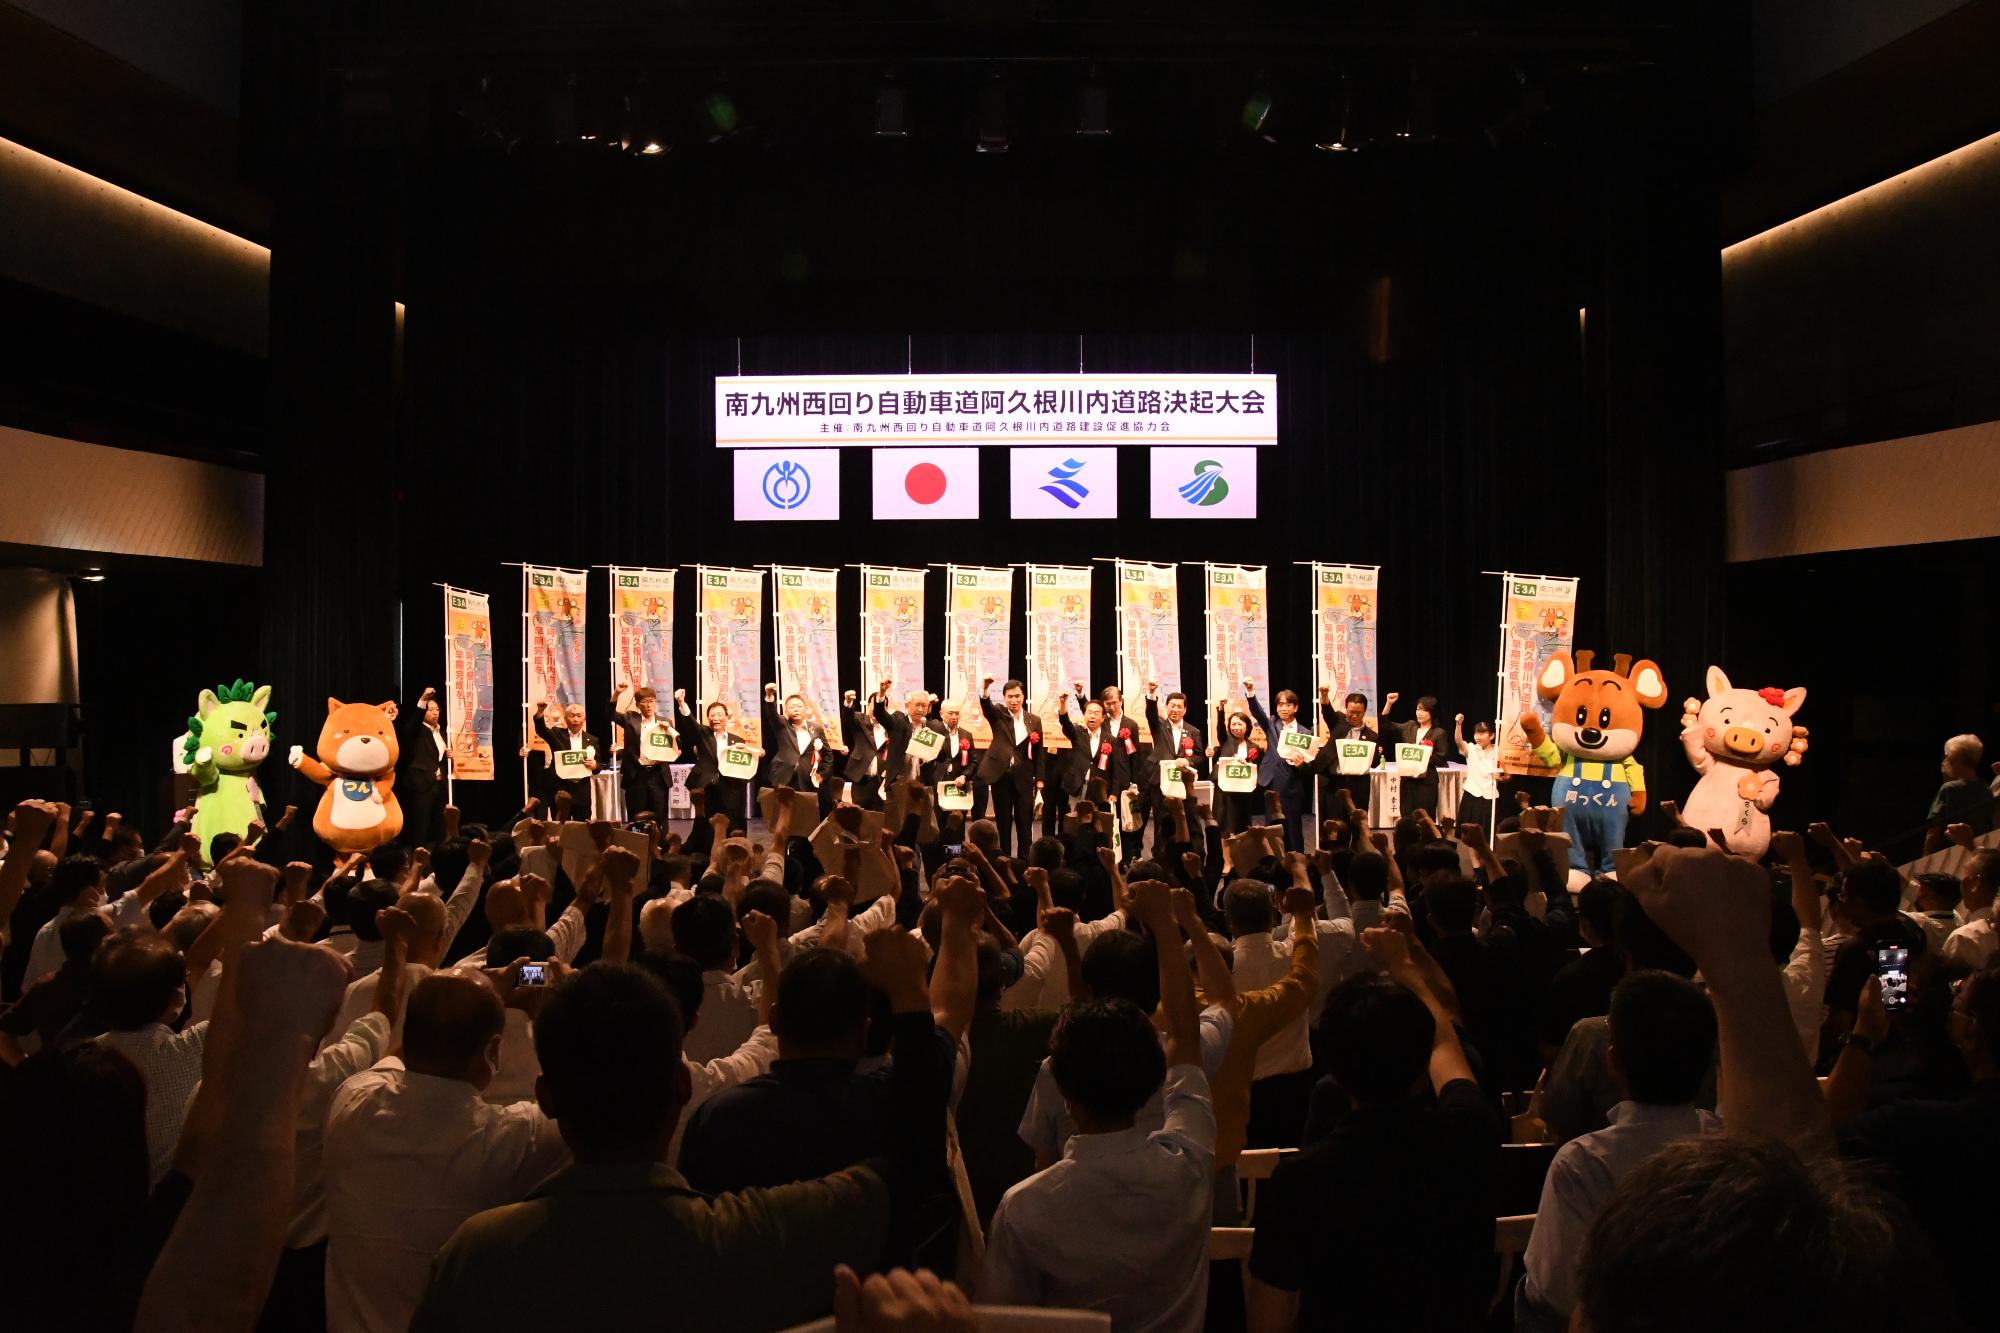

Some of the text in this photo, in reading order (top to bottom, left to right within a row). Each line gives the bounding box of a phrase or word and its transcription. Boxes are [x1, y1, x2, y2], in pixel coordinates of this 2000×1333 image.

[725, 390, 1266, 416] 南九州西回り自動車道阿久根川内道路決起大会
[783, 575, 803, 585] E3A
[957, 574, 977, 585] E3A
[1036, 574, 1056, 584] E3A
[1125, 569, 1144, 580] E3A
[1214, 572, 1234, 583] E3A
[1322, 572, 1342, 583] E3A
[1345, 573, 1373, 582] 南九州道
[619, 576, 639, 587] E3A
[707, 575, 728, 586] E3A
[871, 575, 891, 586] E3A
[1514, 583, 1537, 596] E3A
[1539, 585, 1571, 594] 南九州道
[1324, 624, 1334, 680] 早期完成を！
[1520, 639, 1536, 714] 阿久根川内道路
[1288, 734, 1310, 748] E3A
[1346, 745, 1367, 756] E3A
[1403, 748, 1422, 761] E3A
[564, 754, 585, 765] E3A
[729, 751, 750, 765] E3A
[1170, 769, 1182, 780] E3
[1228, 767, 1249, 778] E3A
[1565, 790, 1618, 807] 阿っくん
